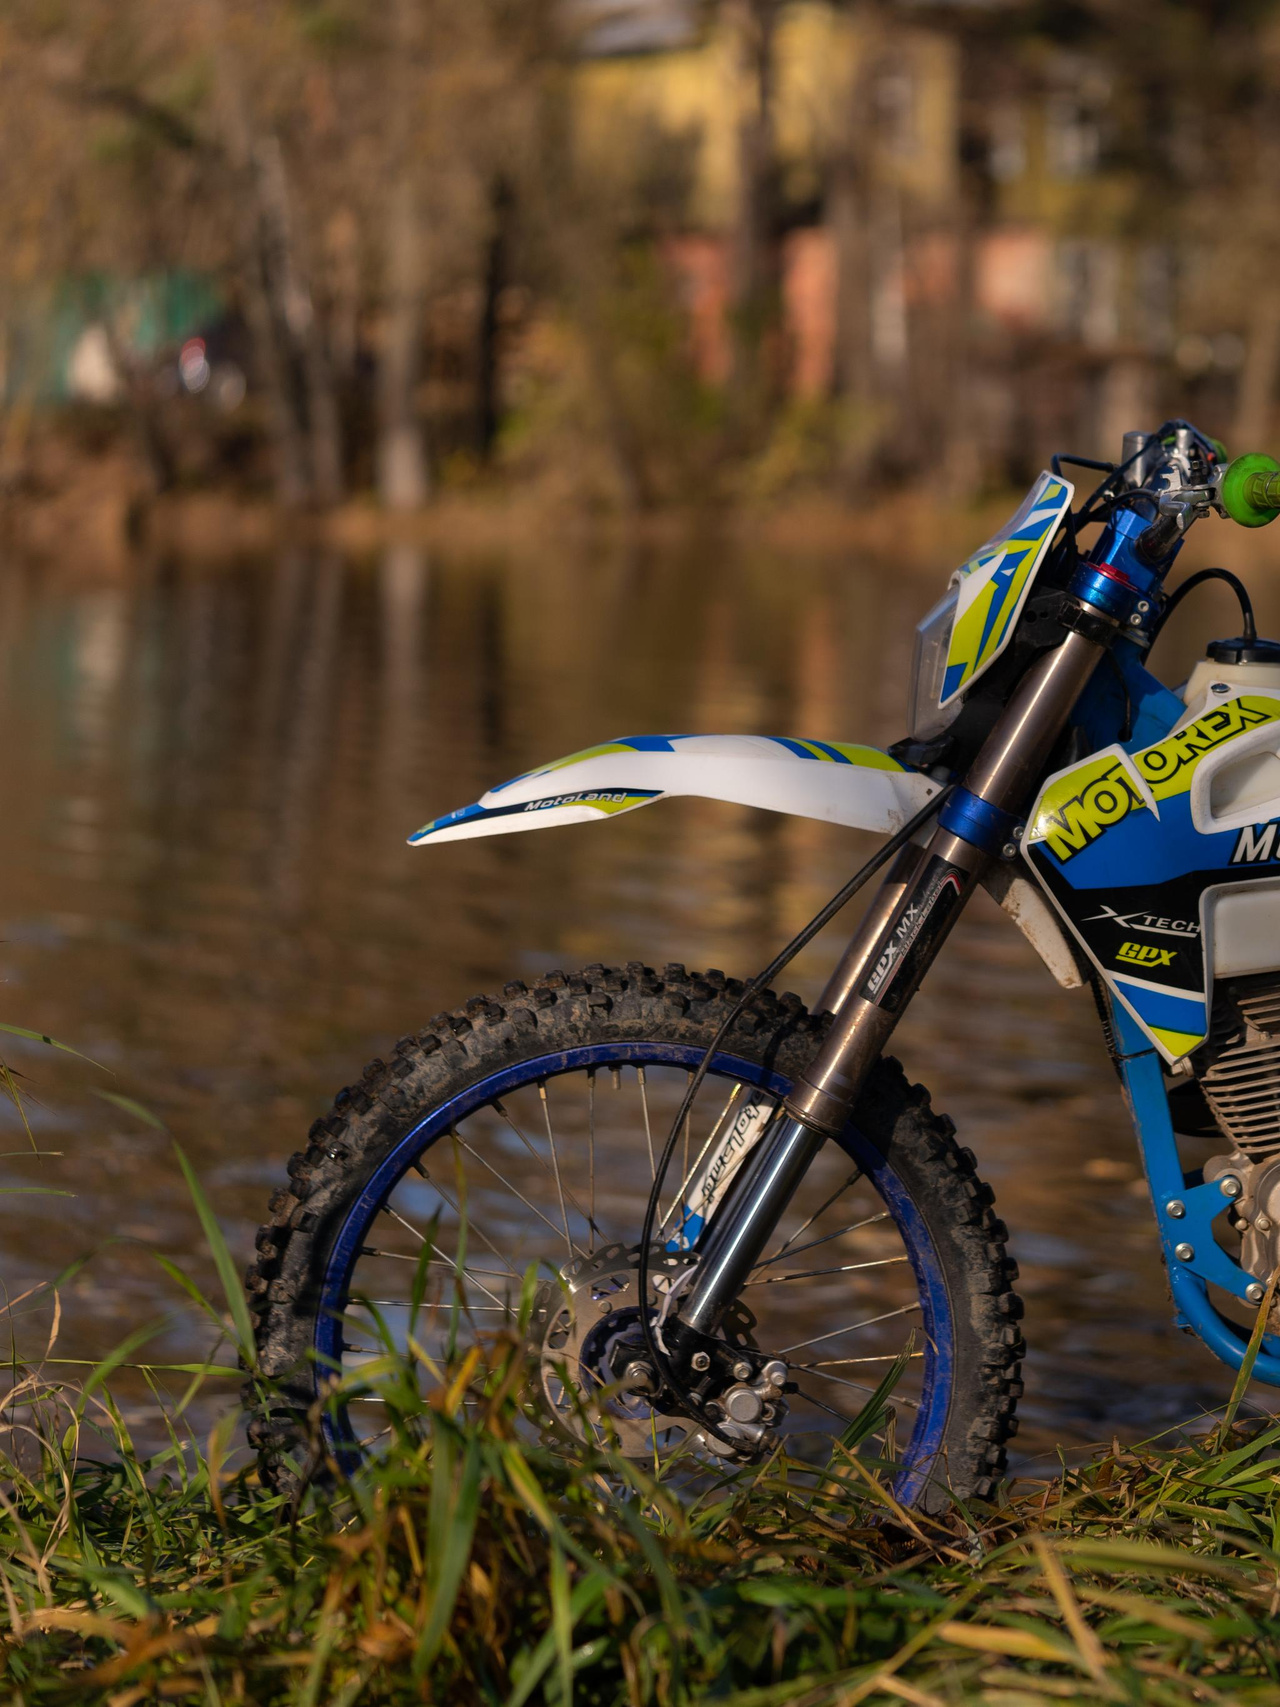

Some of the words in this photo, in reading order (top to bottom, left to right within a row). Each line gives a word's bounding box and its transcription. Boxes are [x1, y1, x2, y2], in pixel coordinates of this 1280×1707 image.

[524, 792, 627, 812] MotoLand
[1044, 697, 1272, 865] MOTOREX
[867, 940, 897, 995] GPX
[896, 903, 918, 939] MX
[1115, 941, 1178, 967] GPX
